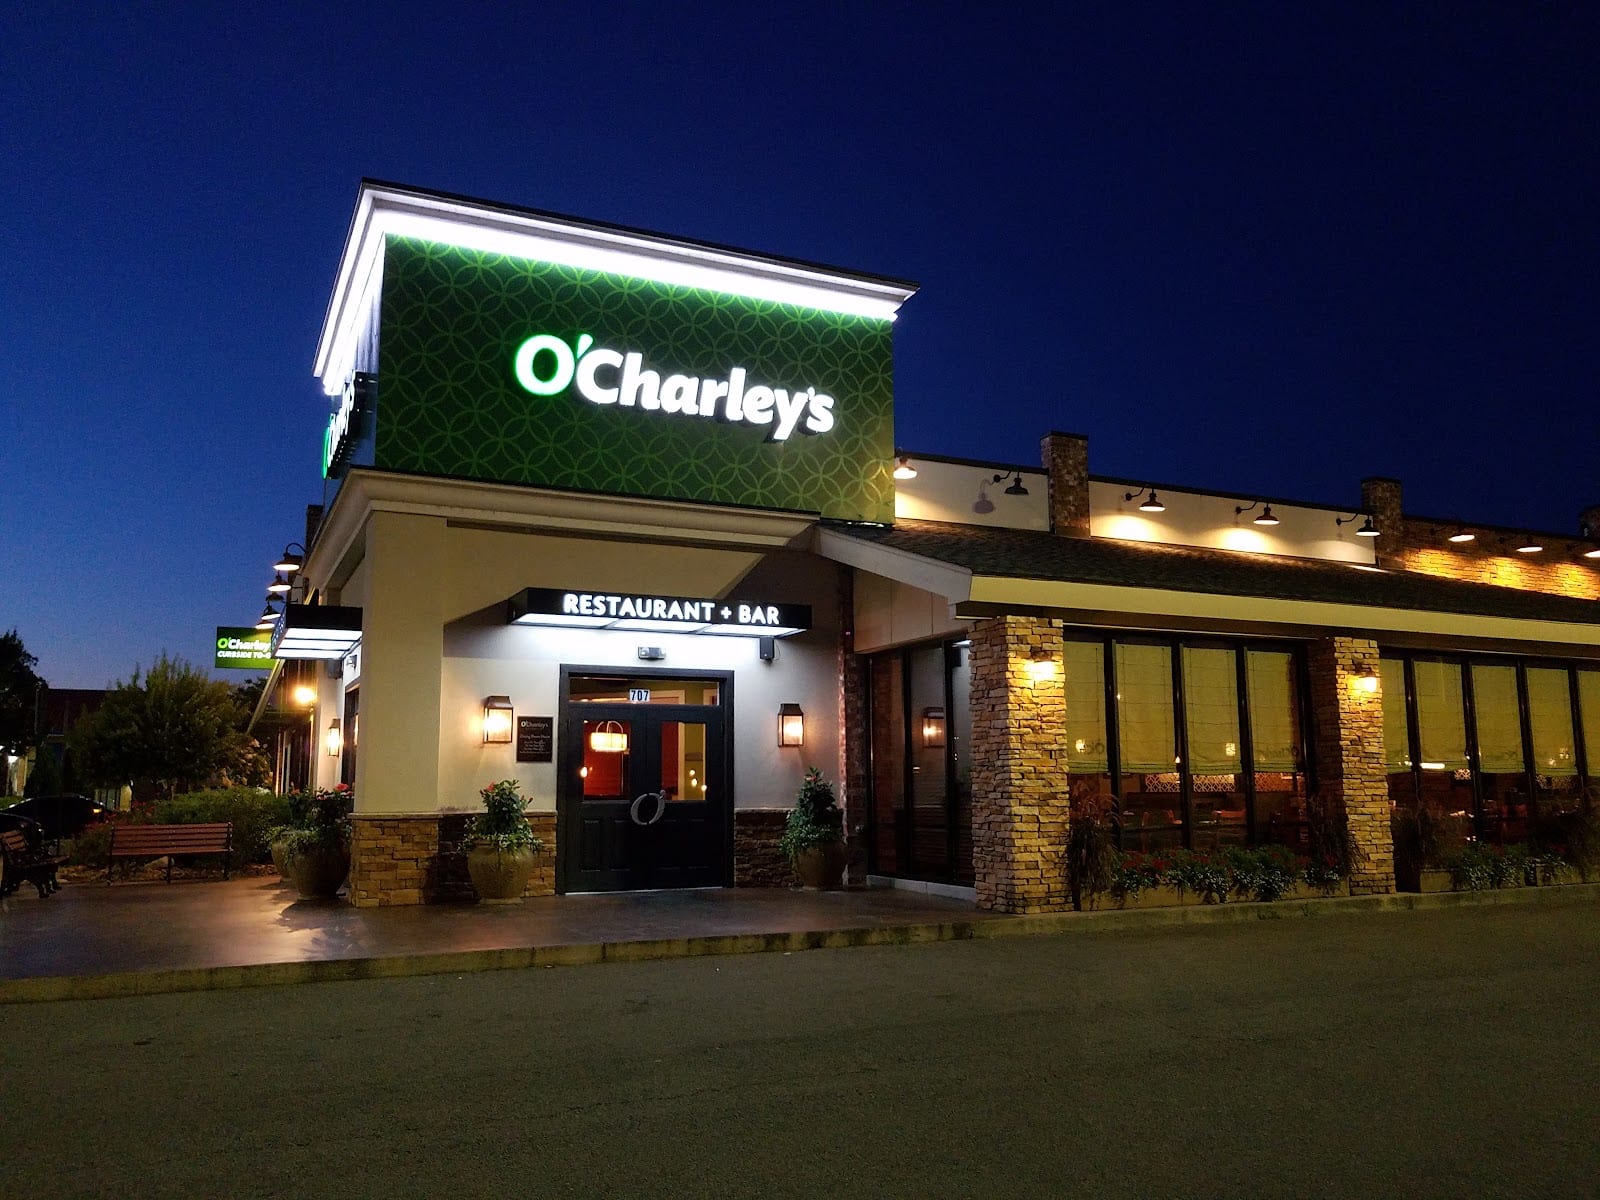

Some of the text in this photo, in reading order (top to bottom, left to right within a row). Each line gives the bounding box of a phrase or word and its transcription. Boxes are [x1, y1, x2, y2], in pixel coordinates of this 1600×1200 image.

[514, 333, 835, 440] O'Charley's
[562, 593, 716, 621] RESTAURANT
[738, 604, 780, 625] BAR
[217, 637, 271, 653] O'Charley
[253, 651, 271, 660] TO-G
[631, 690, 649, 701] 707
